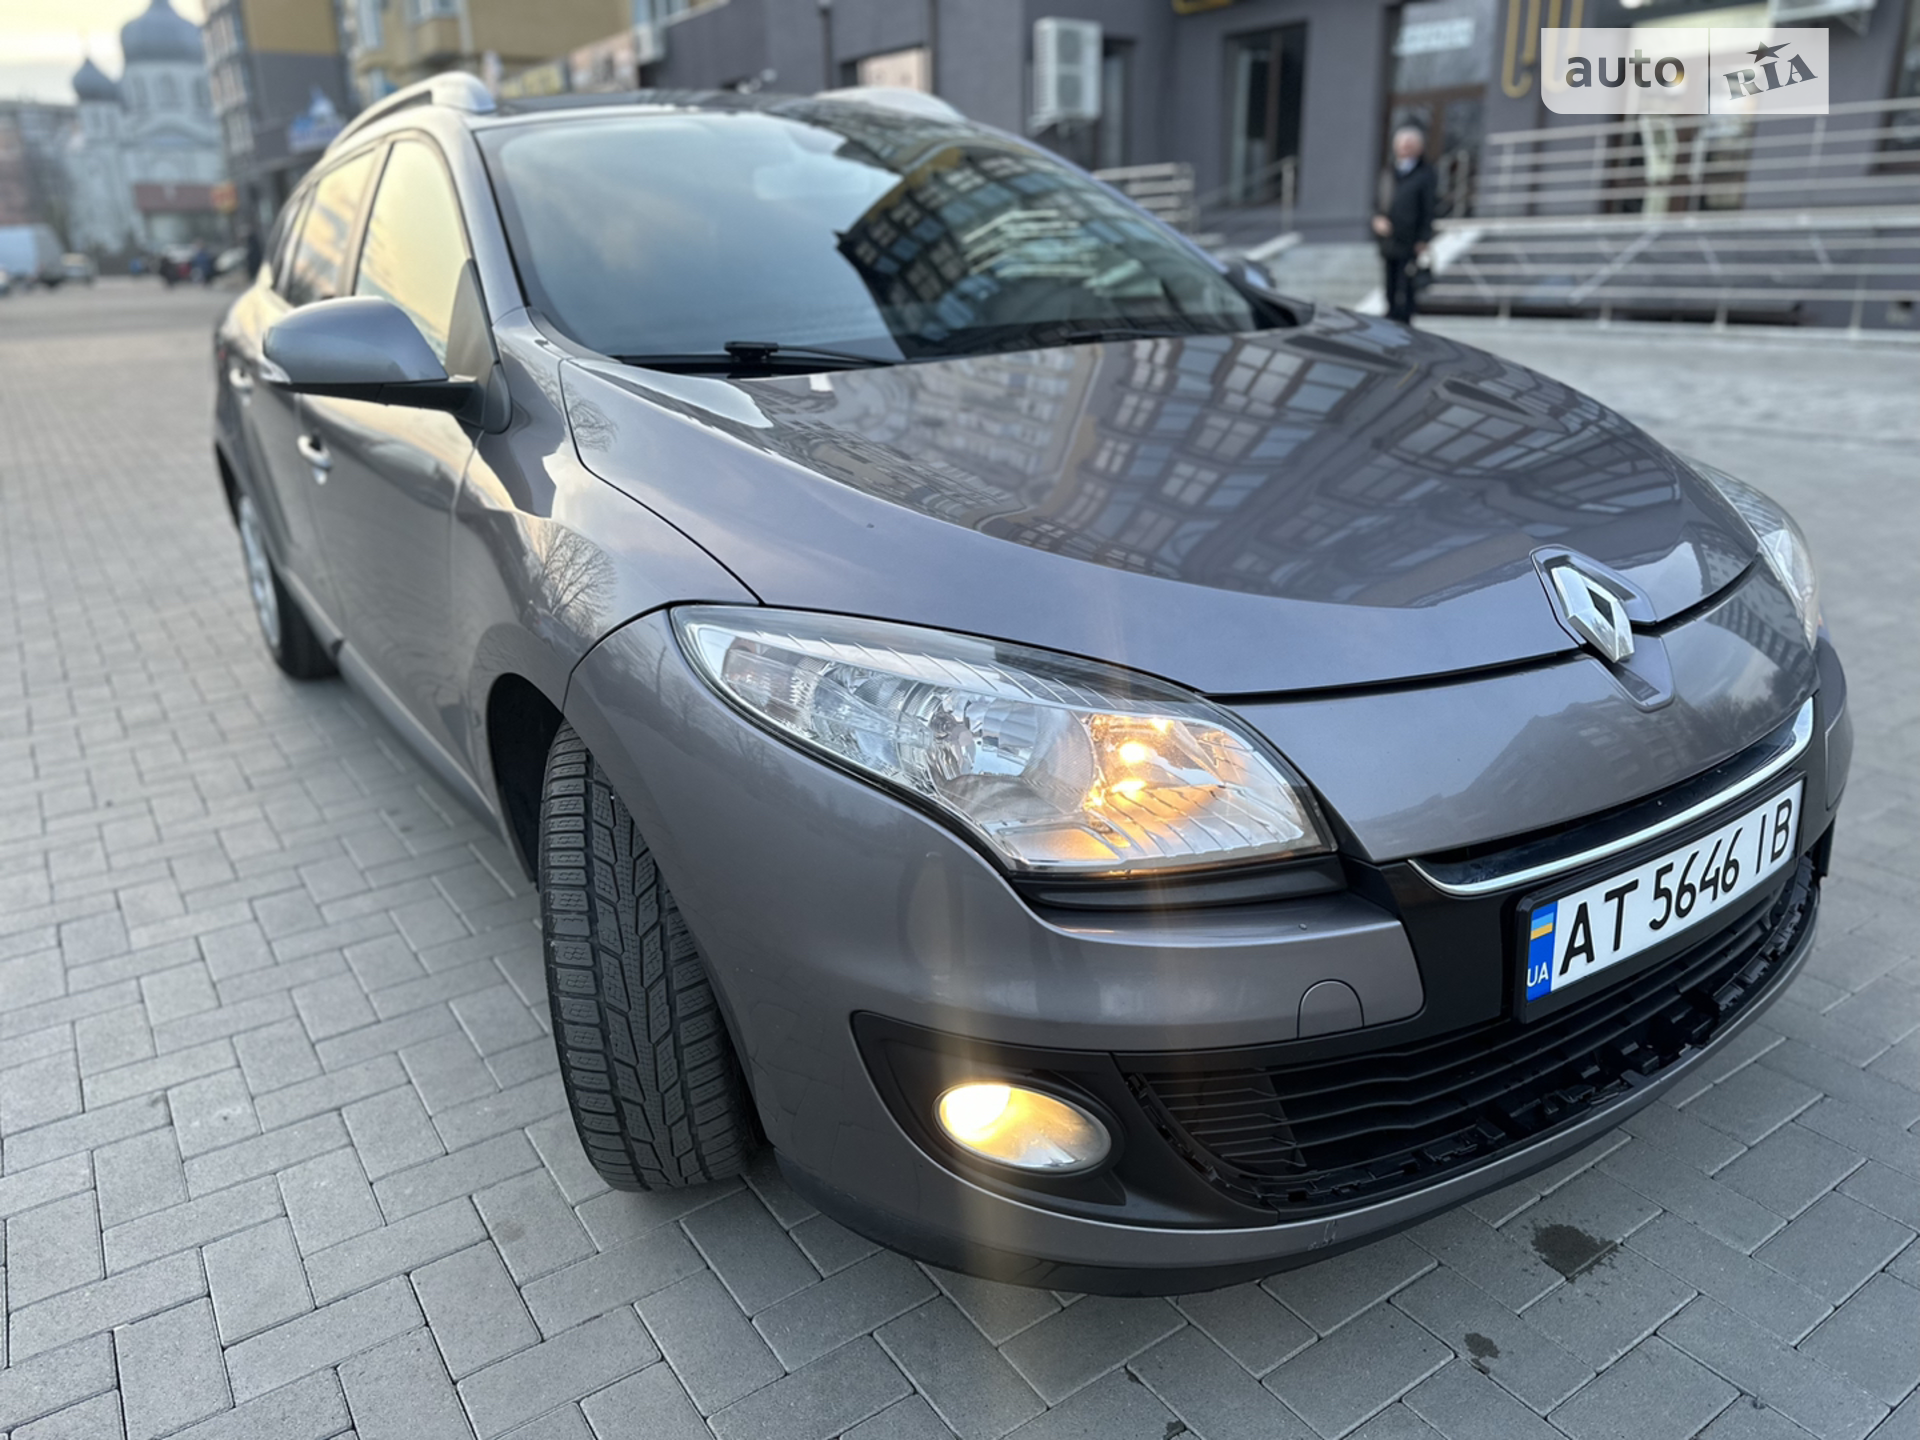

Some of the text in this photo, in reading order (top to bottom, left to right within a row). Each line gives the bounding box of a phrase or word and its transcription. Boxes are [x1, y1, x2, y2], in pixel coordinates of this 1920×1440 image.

[1560, 798, 1793, 975] AT 5646 IB
[1527, 963, 1549, 988] UA
